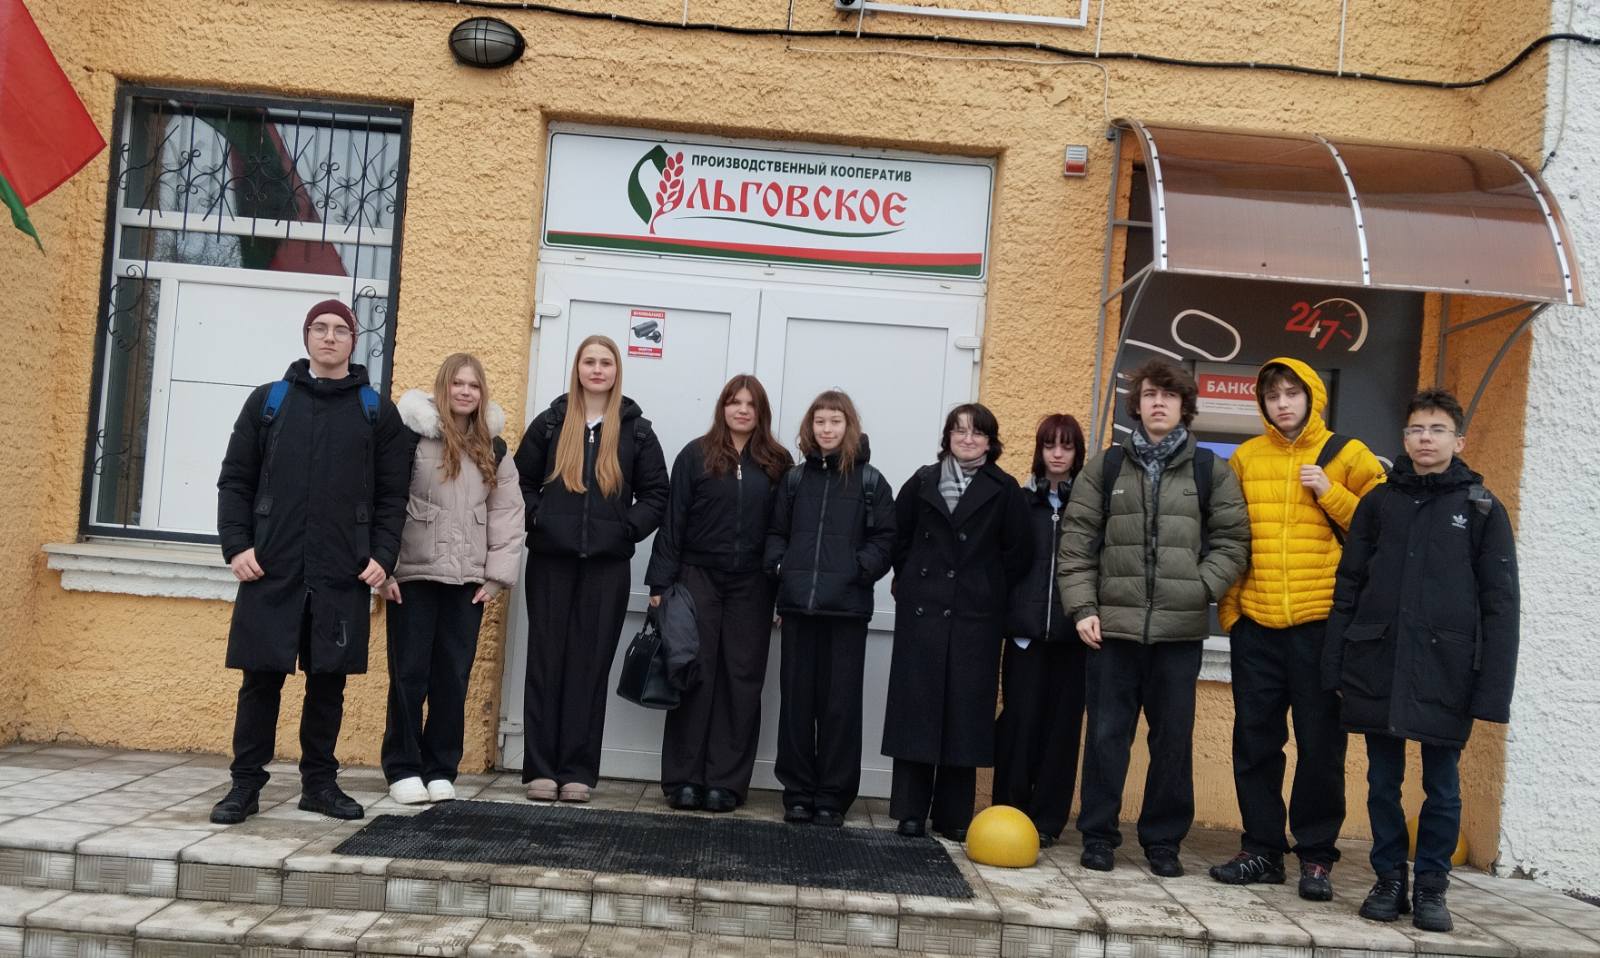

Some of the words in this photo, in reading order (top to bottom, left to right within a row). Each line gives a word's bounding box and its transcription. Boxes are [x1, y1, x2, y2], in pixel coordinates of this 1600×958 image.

[691, 154, 827, 176] ПРОИЗВОДСТВЕННЫЙ
[830, 166, 912, 182] КООПЕРАТИВ
[1207, 380, 1257, 396] БАНКО
